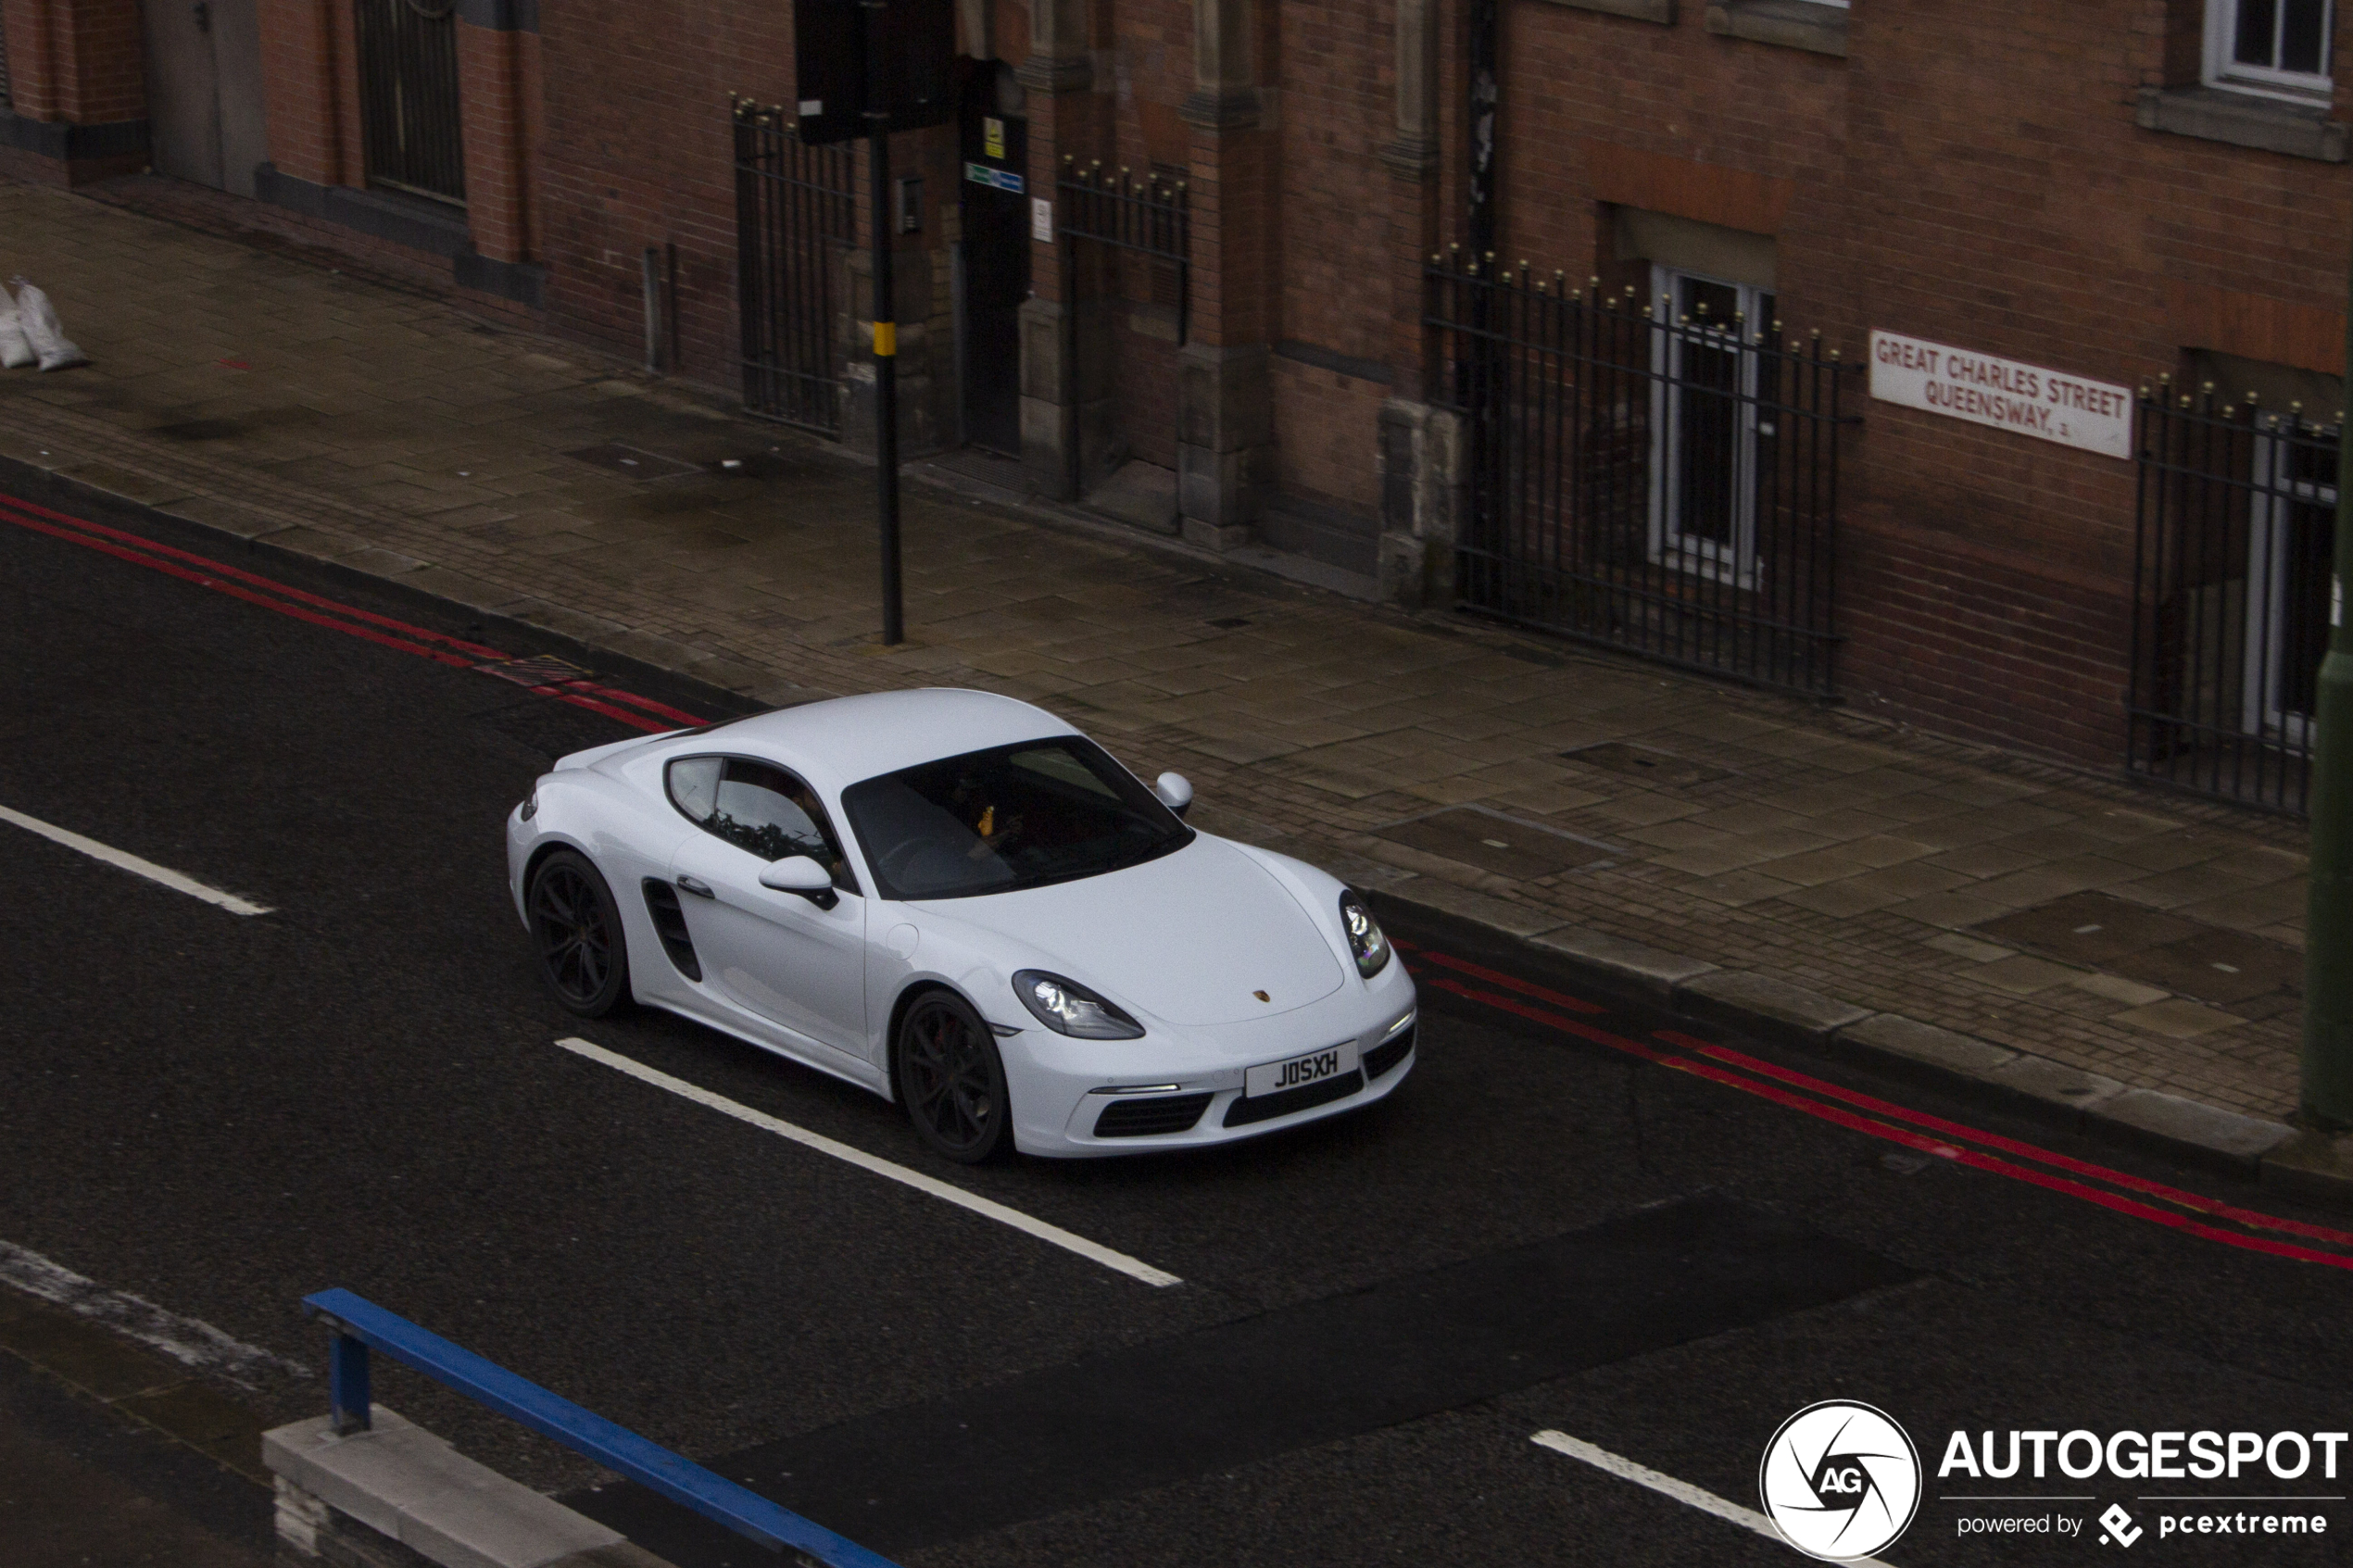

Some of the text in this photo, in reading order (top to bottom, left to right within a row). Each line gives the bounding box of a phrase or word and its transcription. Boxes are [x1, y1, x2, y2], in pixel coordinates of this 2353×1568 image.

[1876, 338, 2126, 419] GREAT CHARLES STREET
